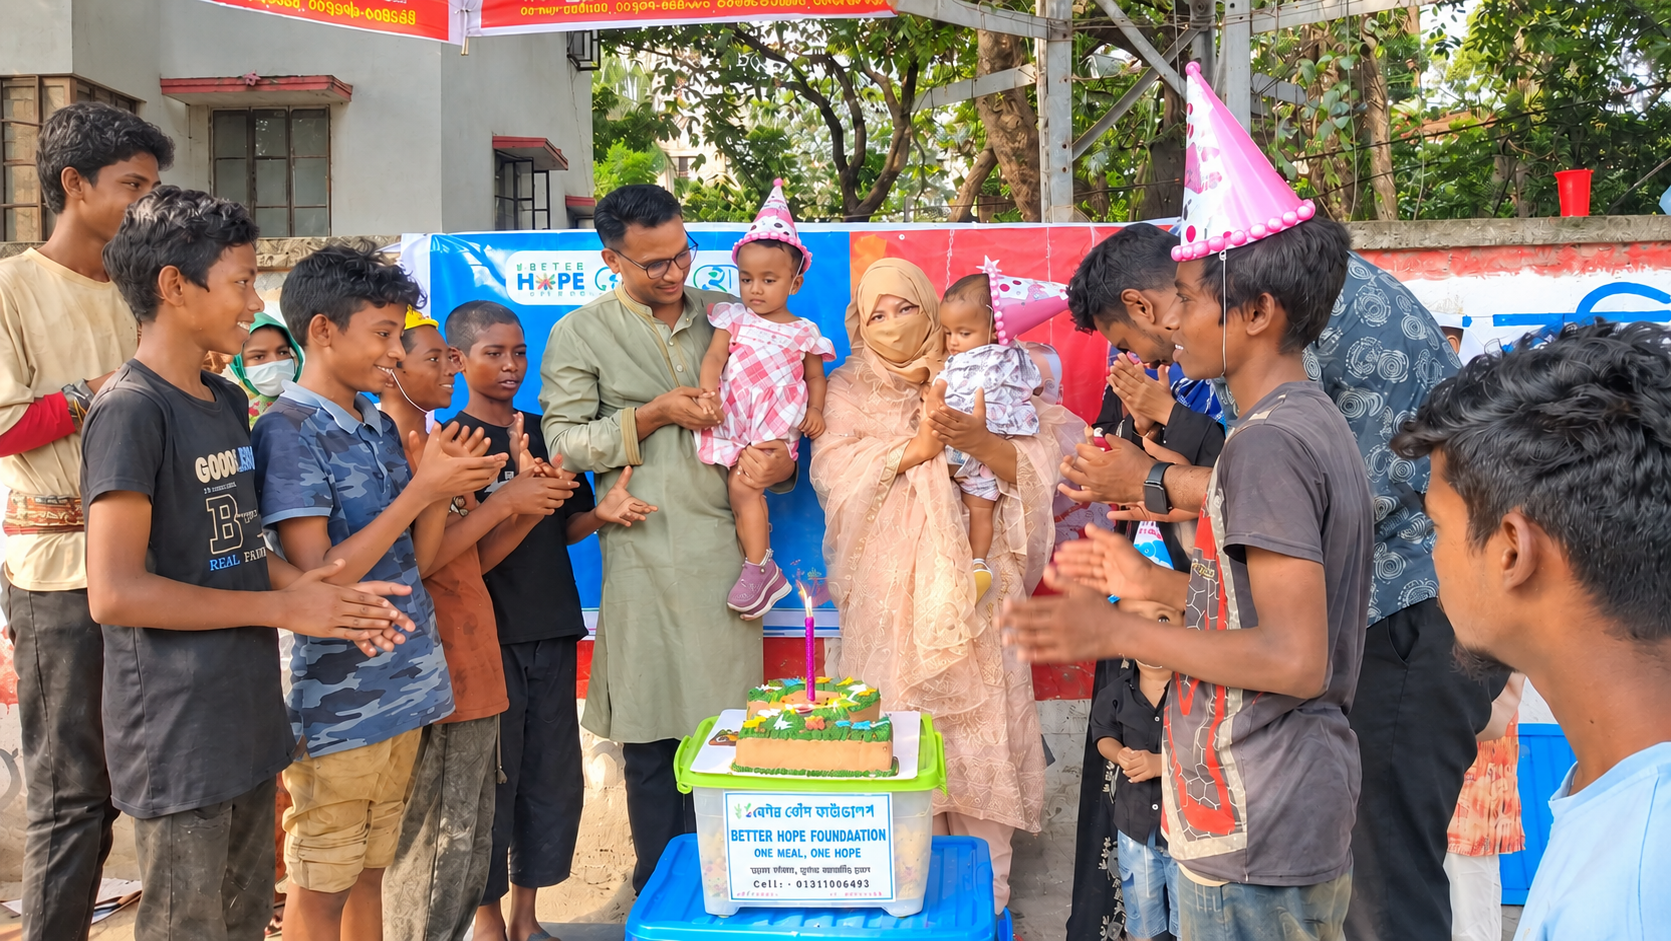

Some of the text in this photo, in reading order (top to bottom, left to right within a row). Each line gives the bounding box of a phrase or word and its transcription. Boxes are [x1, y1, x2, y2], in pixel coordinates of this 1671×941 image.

[209, 554, 240, 571] REAL
[731, 828, 886, 842] BETTER HOPE FOUNDAATION
[754, 847, 861, 859] ONE MEAL, ONE HOPE
[796, 879, 870, 889] 01311006493
